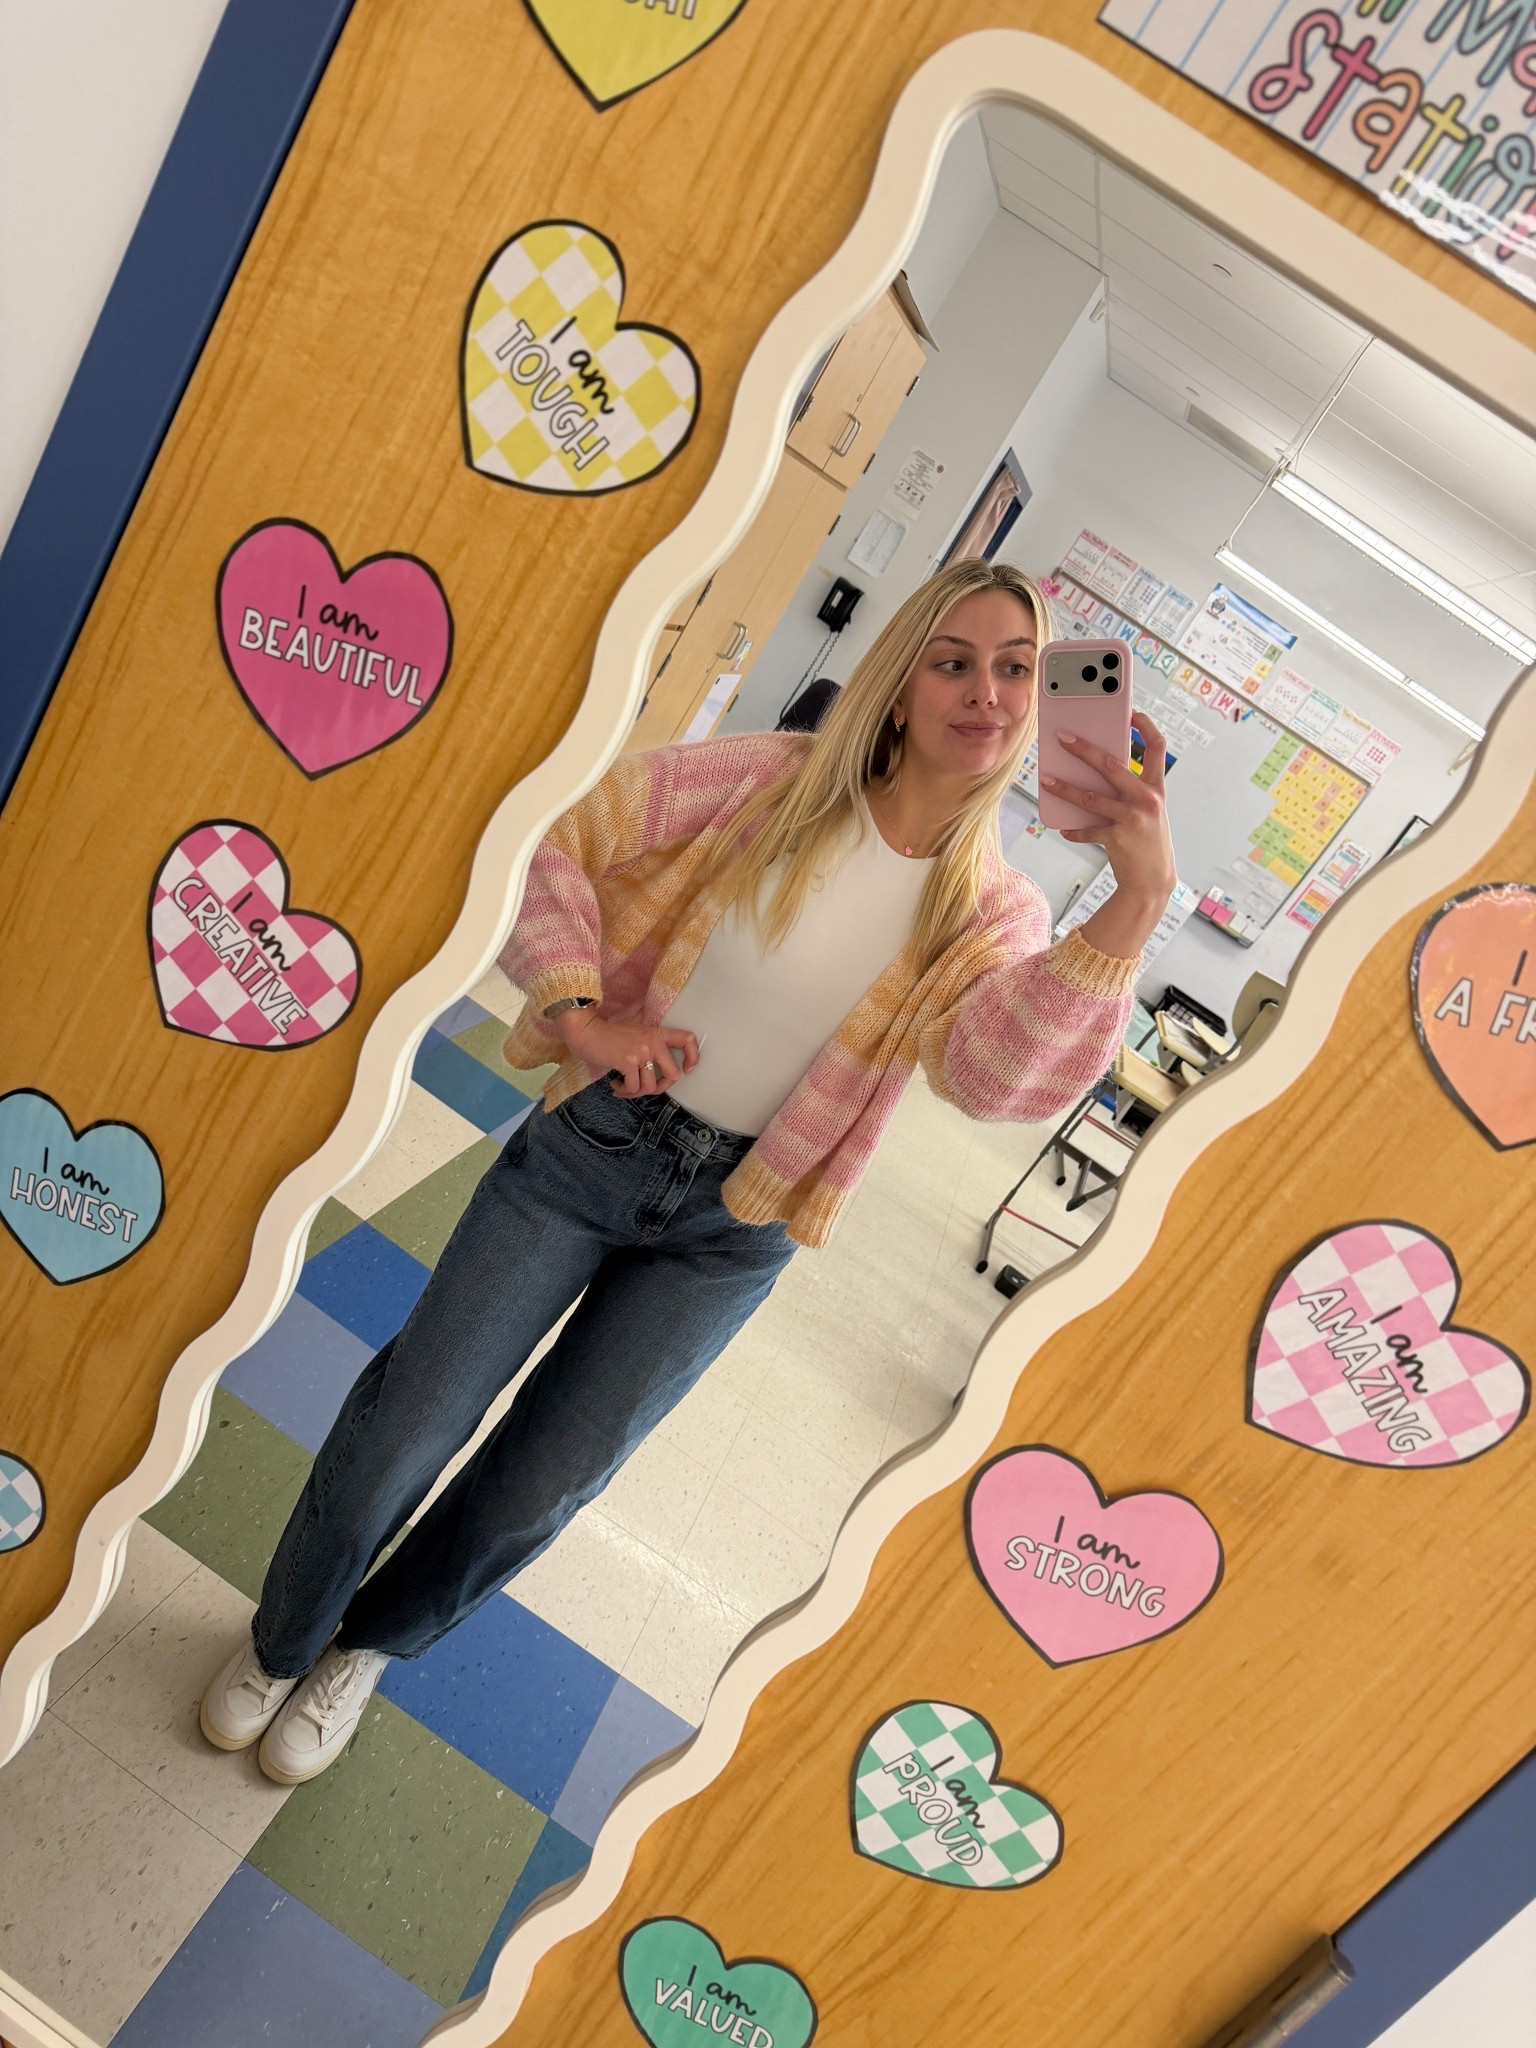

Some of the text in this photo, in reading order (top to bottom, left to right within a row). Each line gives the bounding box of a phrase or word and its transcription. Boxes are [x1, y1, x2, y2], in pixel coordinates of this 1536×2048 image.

[495, 318, 610, 471] TOUGH
[550, 316, 614, 414] I am
[298, 584, 379, 641] I am
[238, 606, 423, 708] BEAUTIFUL
[173, 876, 309, 1036] CREATIVE
[232, 891, 292, 972] I am
[1512, 949, 1528, 987] I
[1434, 976, 1473, 1028] A
[10, 1167, 138, 1243] HONEST
[43, 1146, 110, 1196] I am
[1297, 1287, 1432, 1454] AMAZING
[1370, 1305, 1428, 1394] I am
[1004, 1535, 1165, 1617] STRONG
[1054, 1515, 1140, 1569] I am
[882, 1752, 983, 1866] PROUD
[930, 1755, 985, 1829] I am
[655, 1977, 775, 2048] VALUED
[687, 1965, 757, 2016] I am
